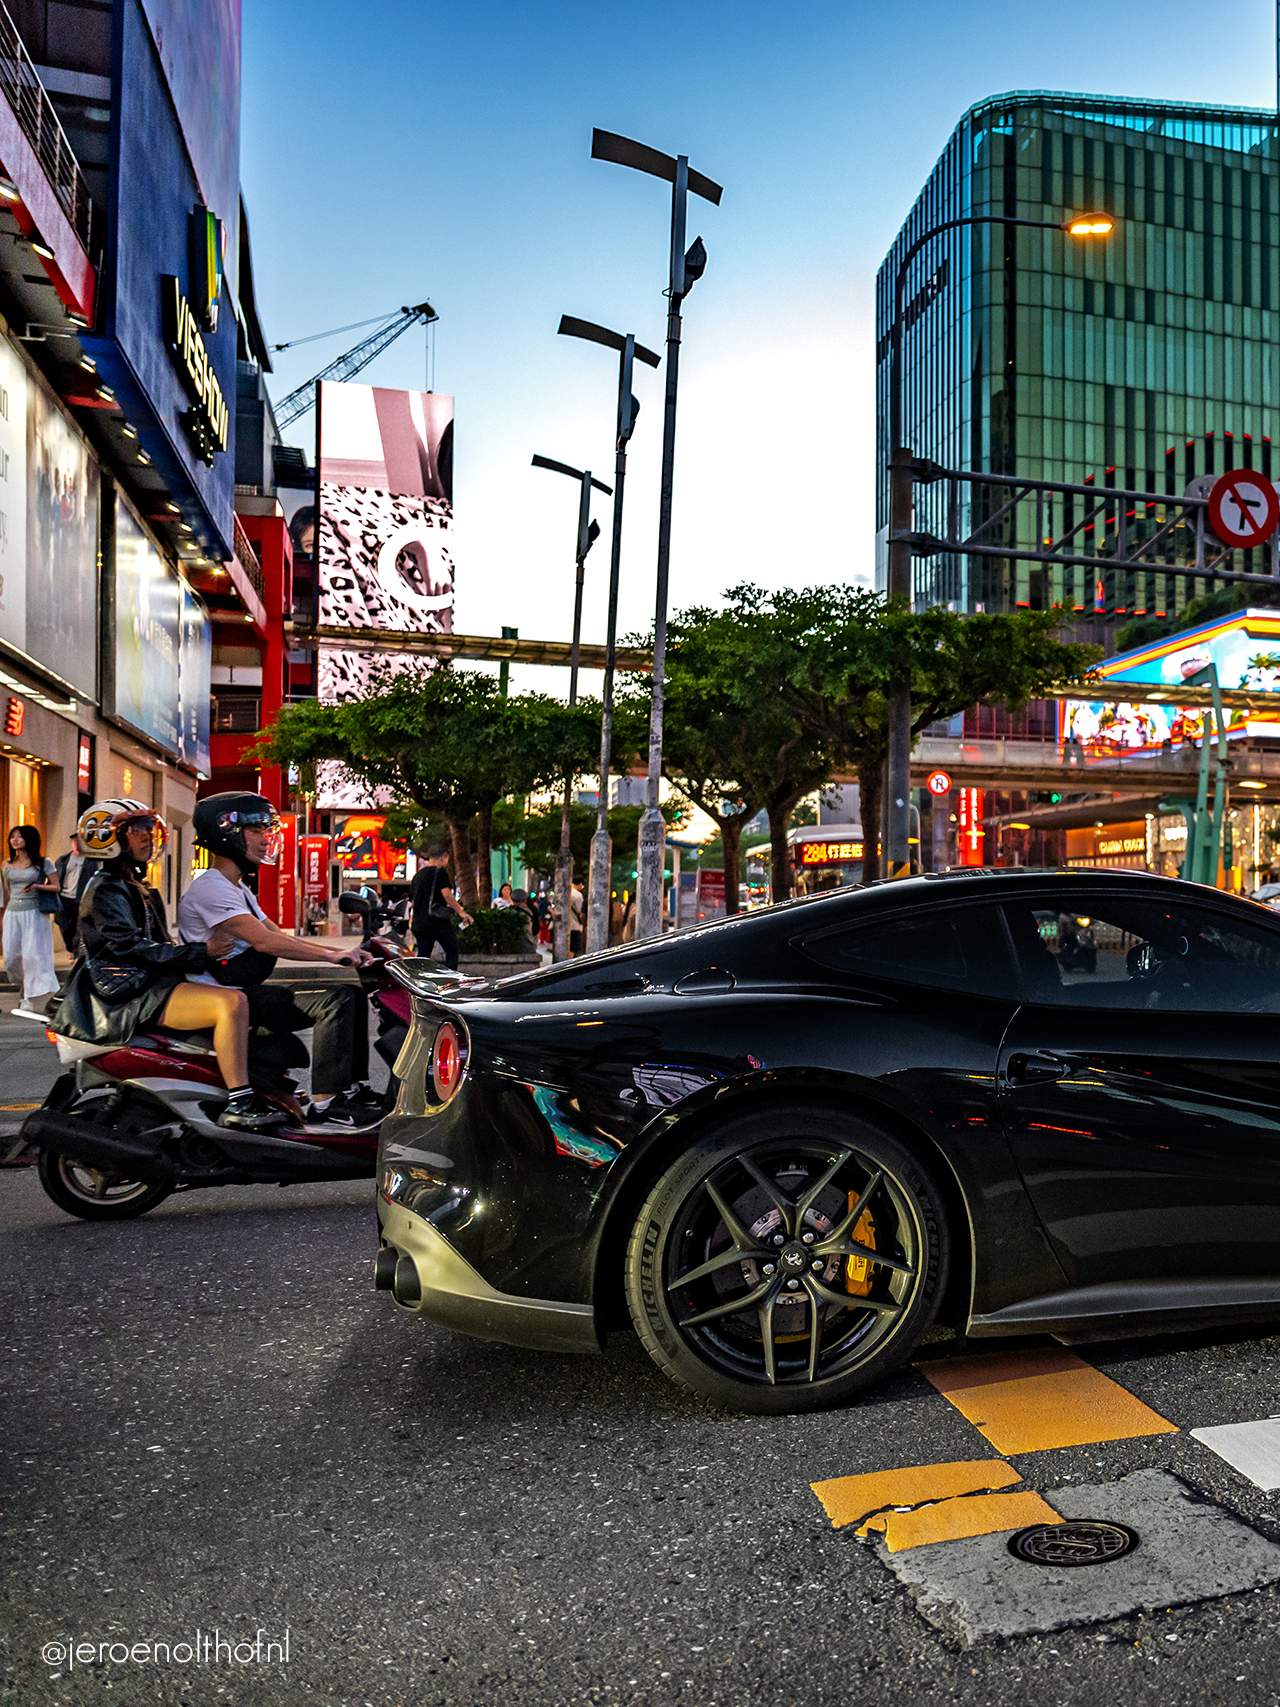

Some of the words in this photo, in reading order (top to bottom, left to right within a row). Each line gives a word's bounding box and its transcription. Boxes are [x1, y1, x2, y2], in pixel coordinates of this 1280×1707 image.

[174, 276, 230, 453] VIESHOW
[656, 1187, 674, 1214] PILOT
[674, 1156, 700, 1185] SPORT
[641, 1225, 665, 1332] MICHELIN
